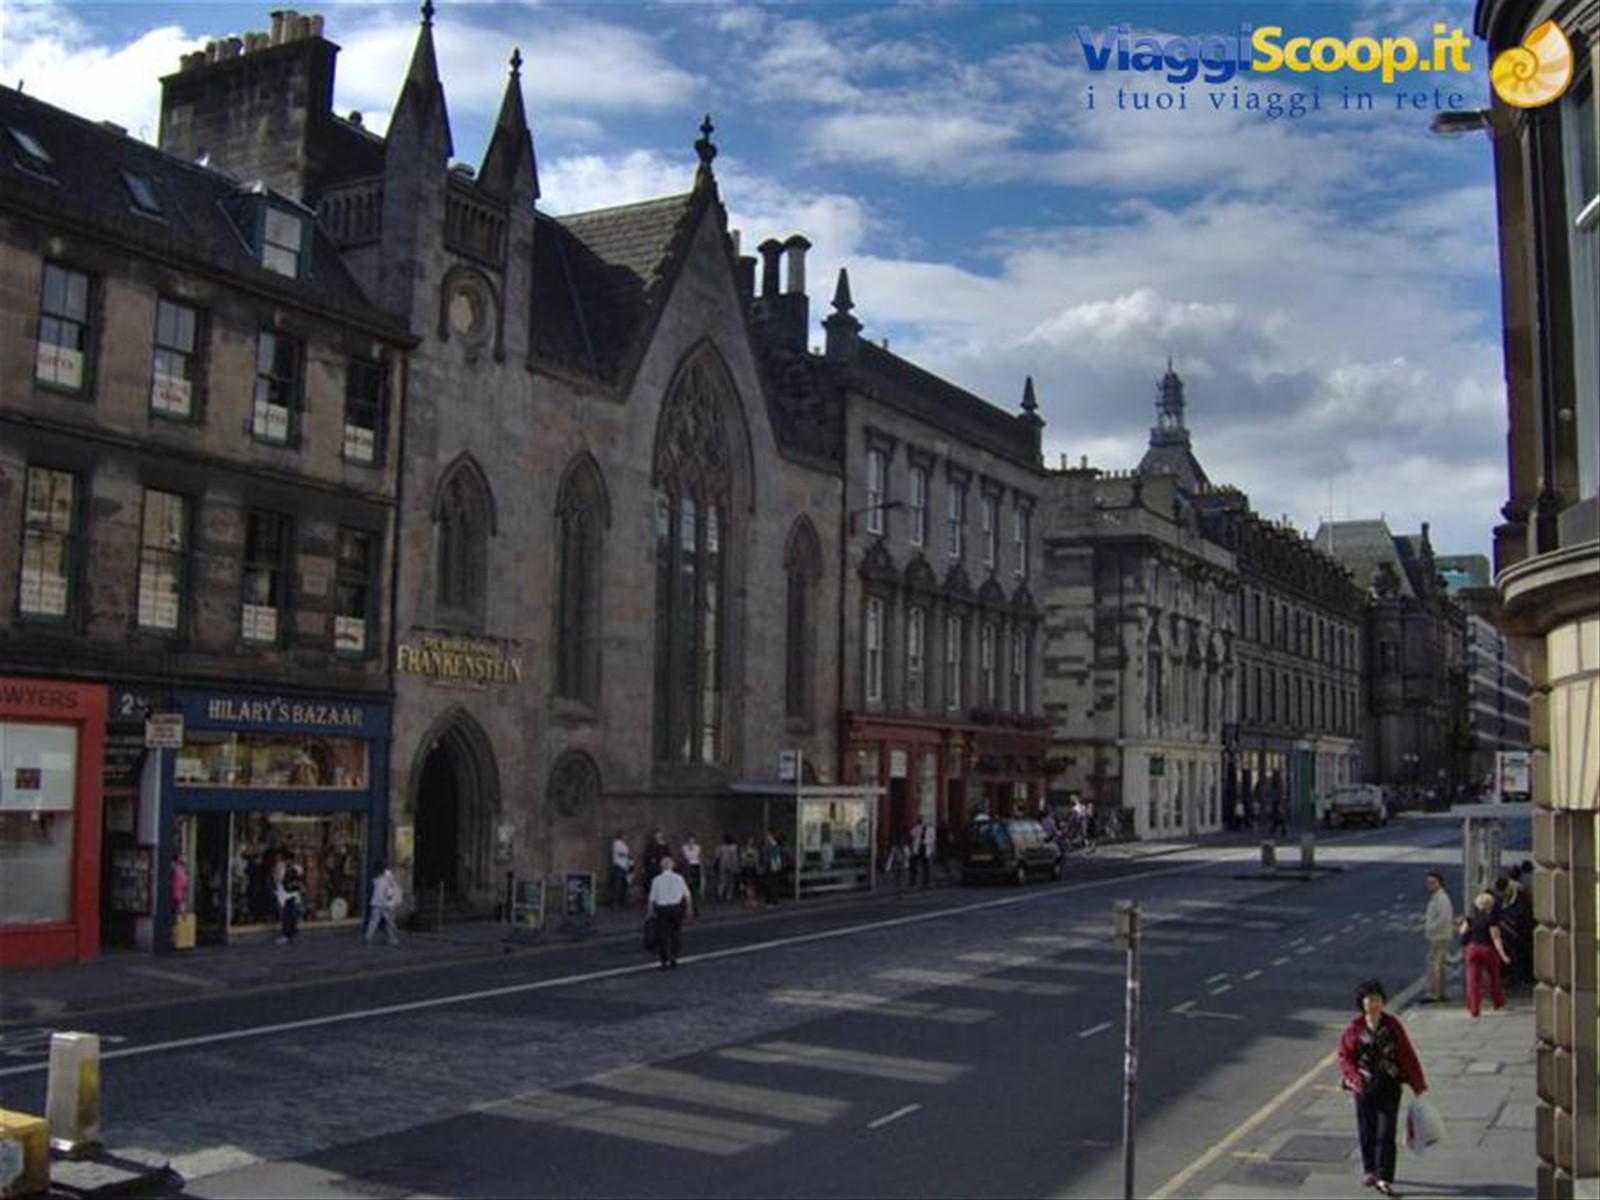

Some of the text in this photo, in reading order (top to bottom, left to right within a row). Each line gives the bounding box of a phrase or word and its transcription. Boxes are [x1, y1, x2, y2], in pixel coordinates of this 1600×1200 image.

[396, 644, 523, 683] FRANKENSTEIN
[0, 685, 78, 710] WYERS
[207, 696, 364, 727] HILARY'S BAZAAR
